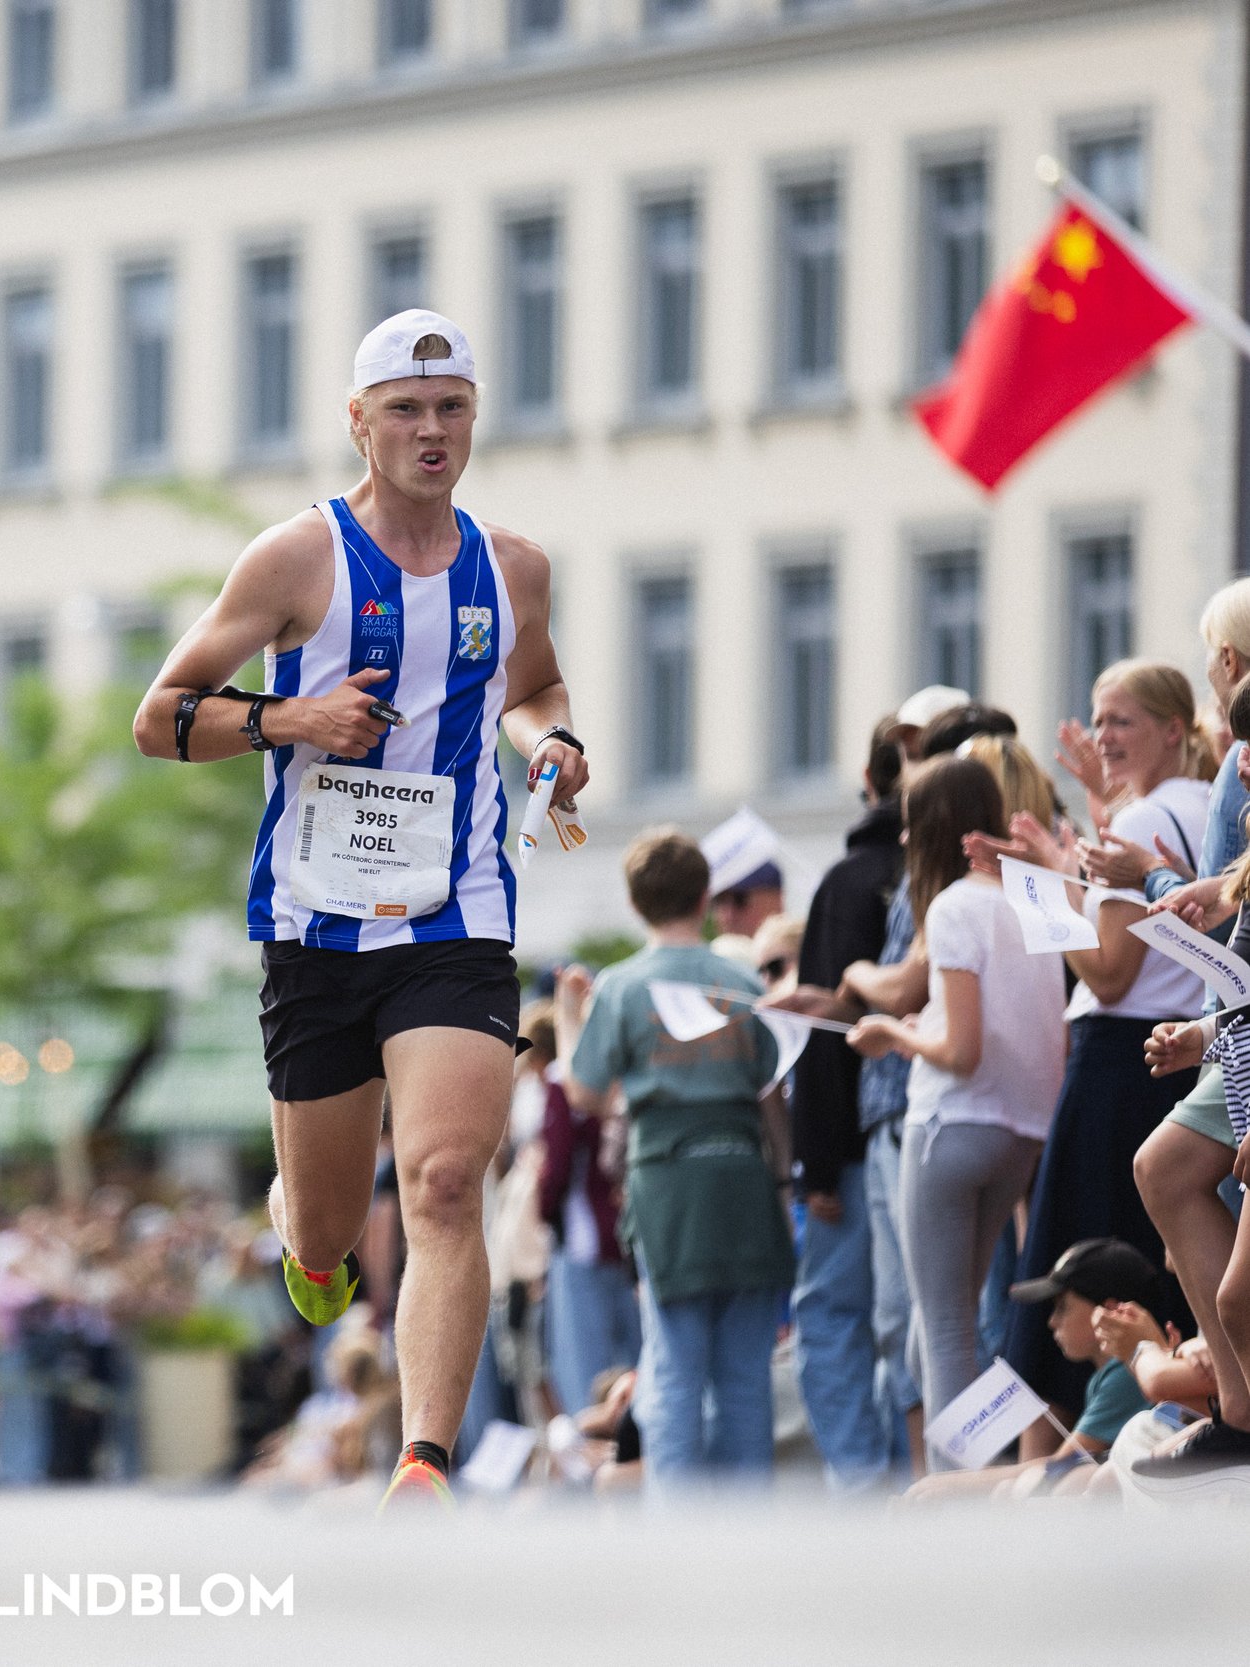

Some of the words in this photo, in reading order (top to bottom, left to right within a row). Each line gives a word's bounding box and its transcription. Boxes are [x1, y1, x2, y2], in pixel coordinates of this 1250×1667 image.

[360, 626, 398, 637] RYGGAR
[317, 774, 435, 804] bagheera
[354, 810, 398, 829] 3985
[349, 833, 396, 853] NOEL
[341, 854, 373, 864] GÖTEBORG
[373, 859, 411, 868] ORIENTERING
[325, 898, 367, 910] CHALMERS
[1180, 940, 1247, 995] CHALMERS
